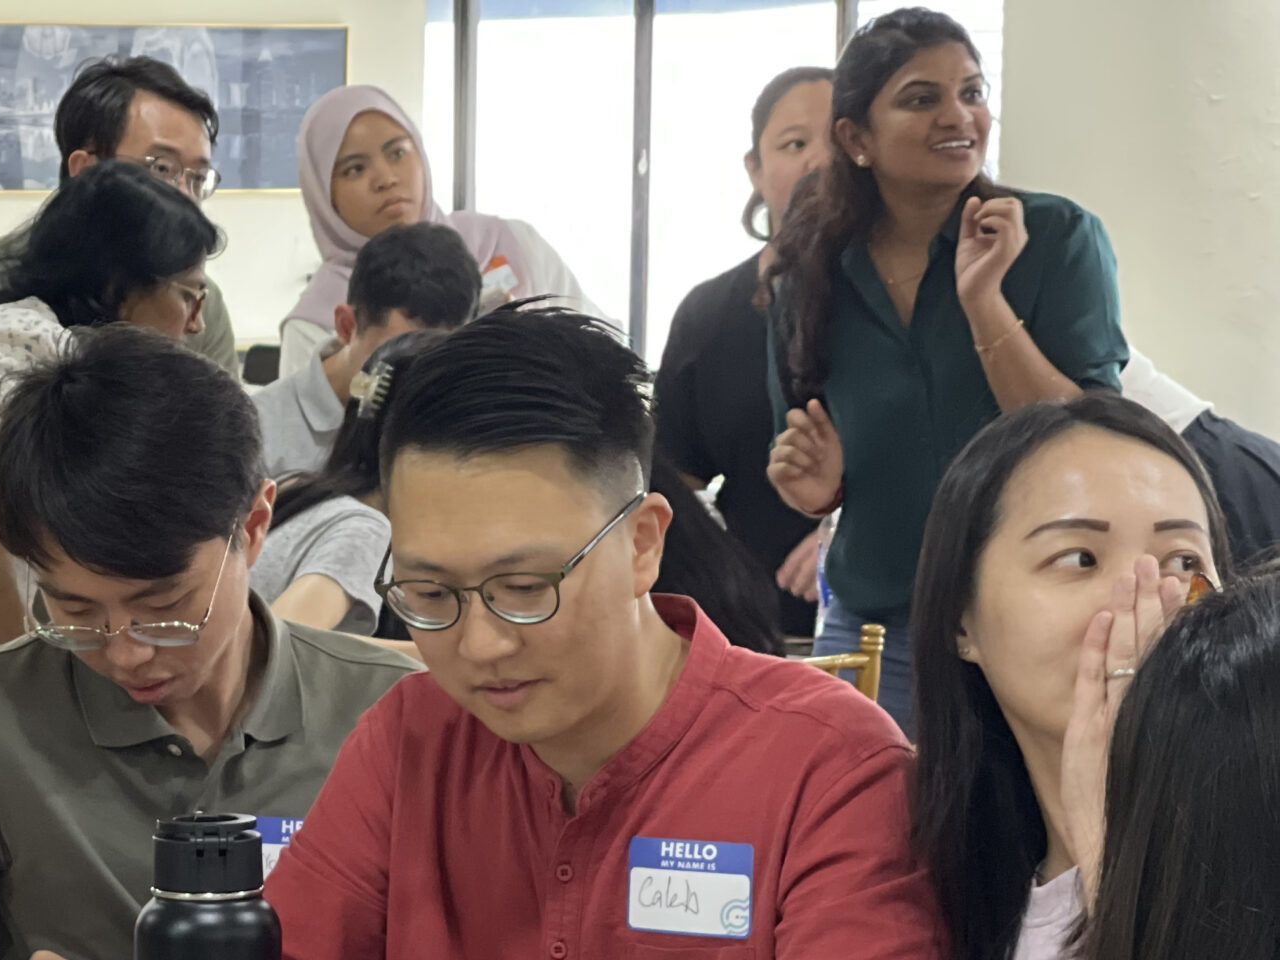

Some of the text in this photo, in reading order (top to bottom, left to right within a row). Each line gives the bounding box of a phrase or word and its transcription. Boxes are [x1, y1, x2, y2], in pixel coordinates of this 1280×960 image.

[660, 841, 718, 860] HELLO
[660, 860, 716, 871] MY NAME IS
[638, 876, 700, 915] Caleb
